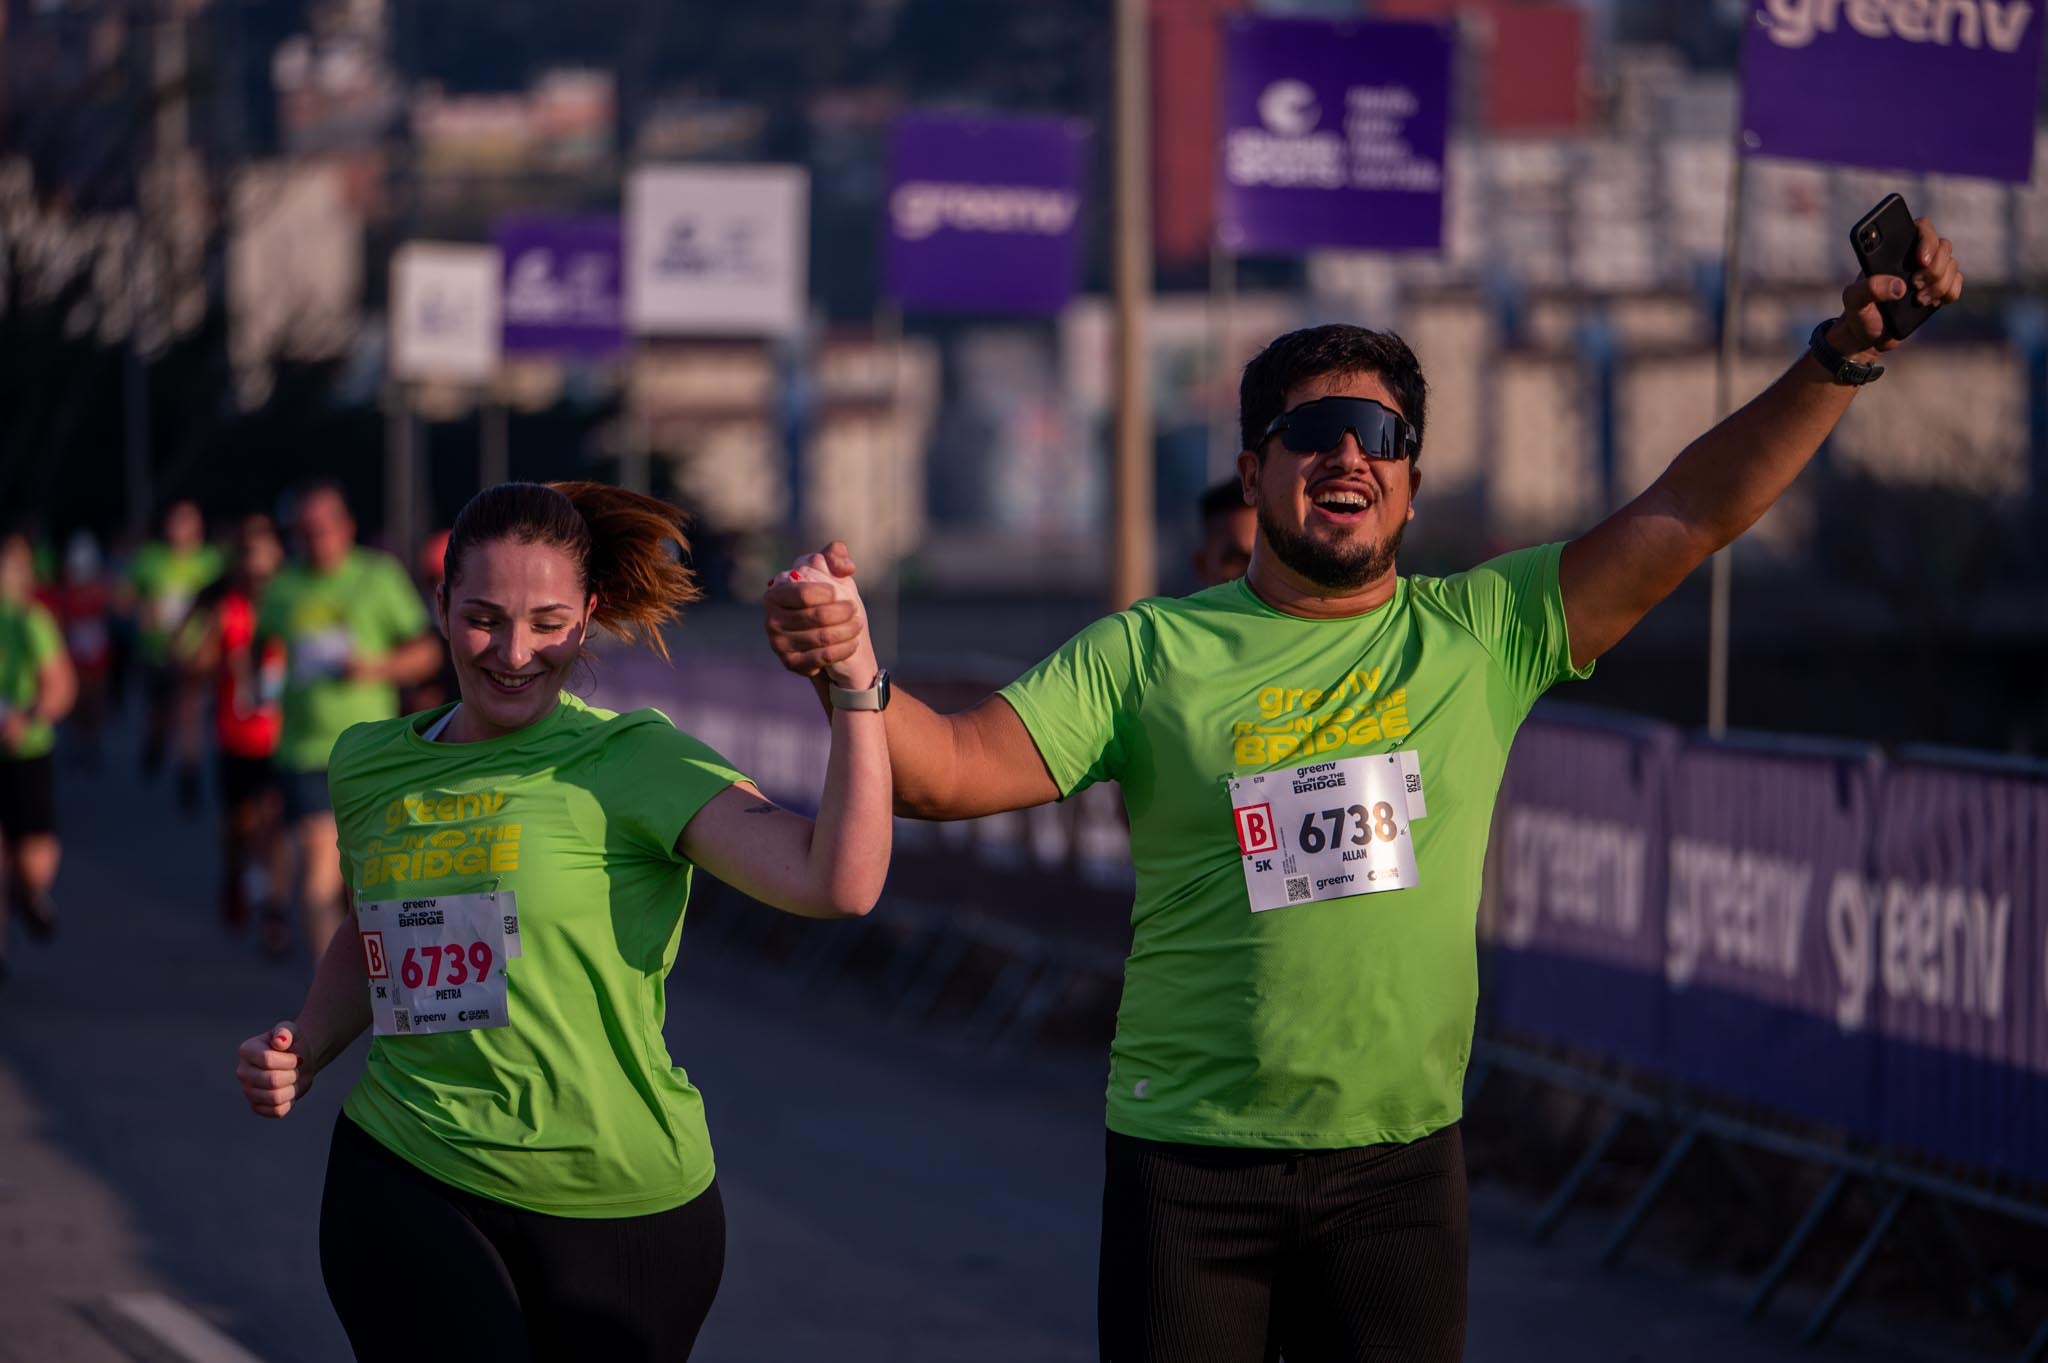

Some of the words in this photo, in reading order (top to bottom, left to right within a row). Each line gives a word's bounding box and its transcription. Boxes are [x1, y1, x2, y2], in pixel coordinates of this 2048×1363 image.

[1258, 667, 1381, 718] grenv
[1234, 706, 1411, 766] BRIDGE
[1296, 761, 1337, 778] greenv
[1292, 776, 1316, 786] RUN
[1293, 777, 1346, 794] BRIDGE
[1405, 773, 1418, 793] 6738
[473, 824, 521, 842] THE
[1246, 812, 1267, 847] B
[1298, 800, 1398, 855] 6738
[1342, 848, 1368, 862] ALLAN
[364, 843, 520, 887] BRIDGE
[1255, 859, 1273, 873] 5K
[1316, 873, 1355, 890] greenv
[402, 899, 437, 912] greenv
[399, 916, 445, 928] BRIDGE
[503, 915, 515, 935] 6739
[368, 938, 382, 972] B
[1826, 870, 2011, 1031] geenv
[400, 941, 493, 989] 6739
[376, 986, 387, 999] 5K
[435, 988, 462, 1001] PIETRA
[413, 1012, 447, 1026] greenv
